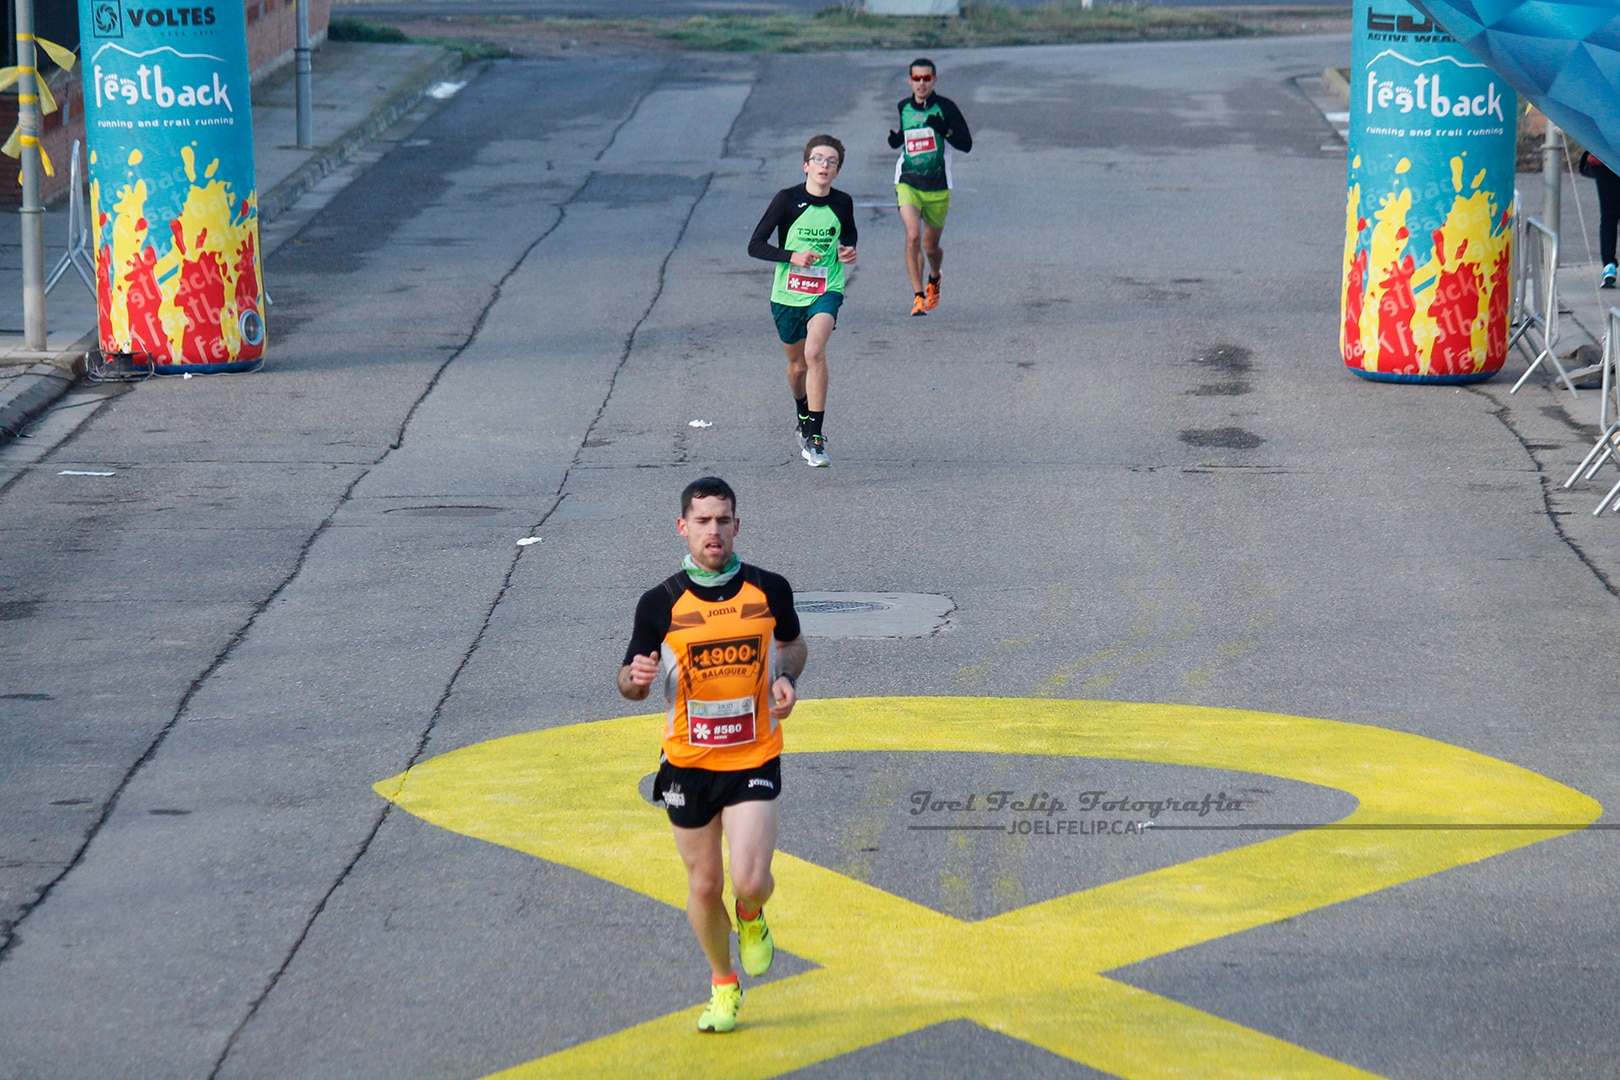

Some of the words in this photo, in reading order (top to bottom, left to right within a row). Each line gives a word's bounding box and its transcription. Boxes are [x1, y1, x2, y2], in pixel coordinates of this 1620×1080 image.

[127, 7, 216, 27] VOLTES
[1367, 33, 1408, 43] ACTIVE
[94, 64, 233, 112] feetback
[1366, 71, 1504, 122] feetback
[98, 119, 133, 129] running
[138, 119, 159, 127] and
[163, 118, 190, 127] trail
[195, 117, 234, 126] running
[1366, 126, 1405, 137] running
[1409, 128, 1432, 137] and
[1435, 127, 1463, 137] trail
[1467, 126, 1504, 136] running
[699, 644, 752, 667] 1900
[713, 723, 742, 735] #580
